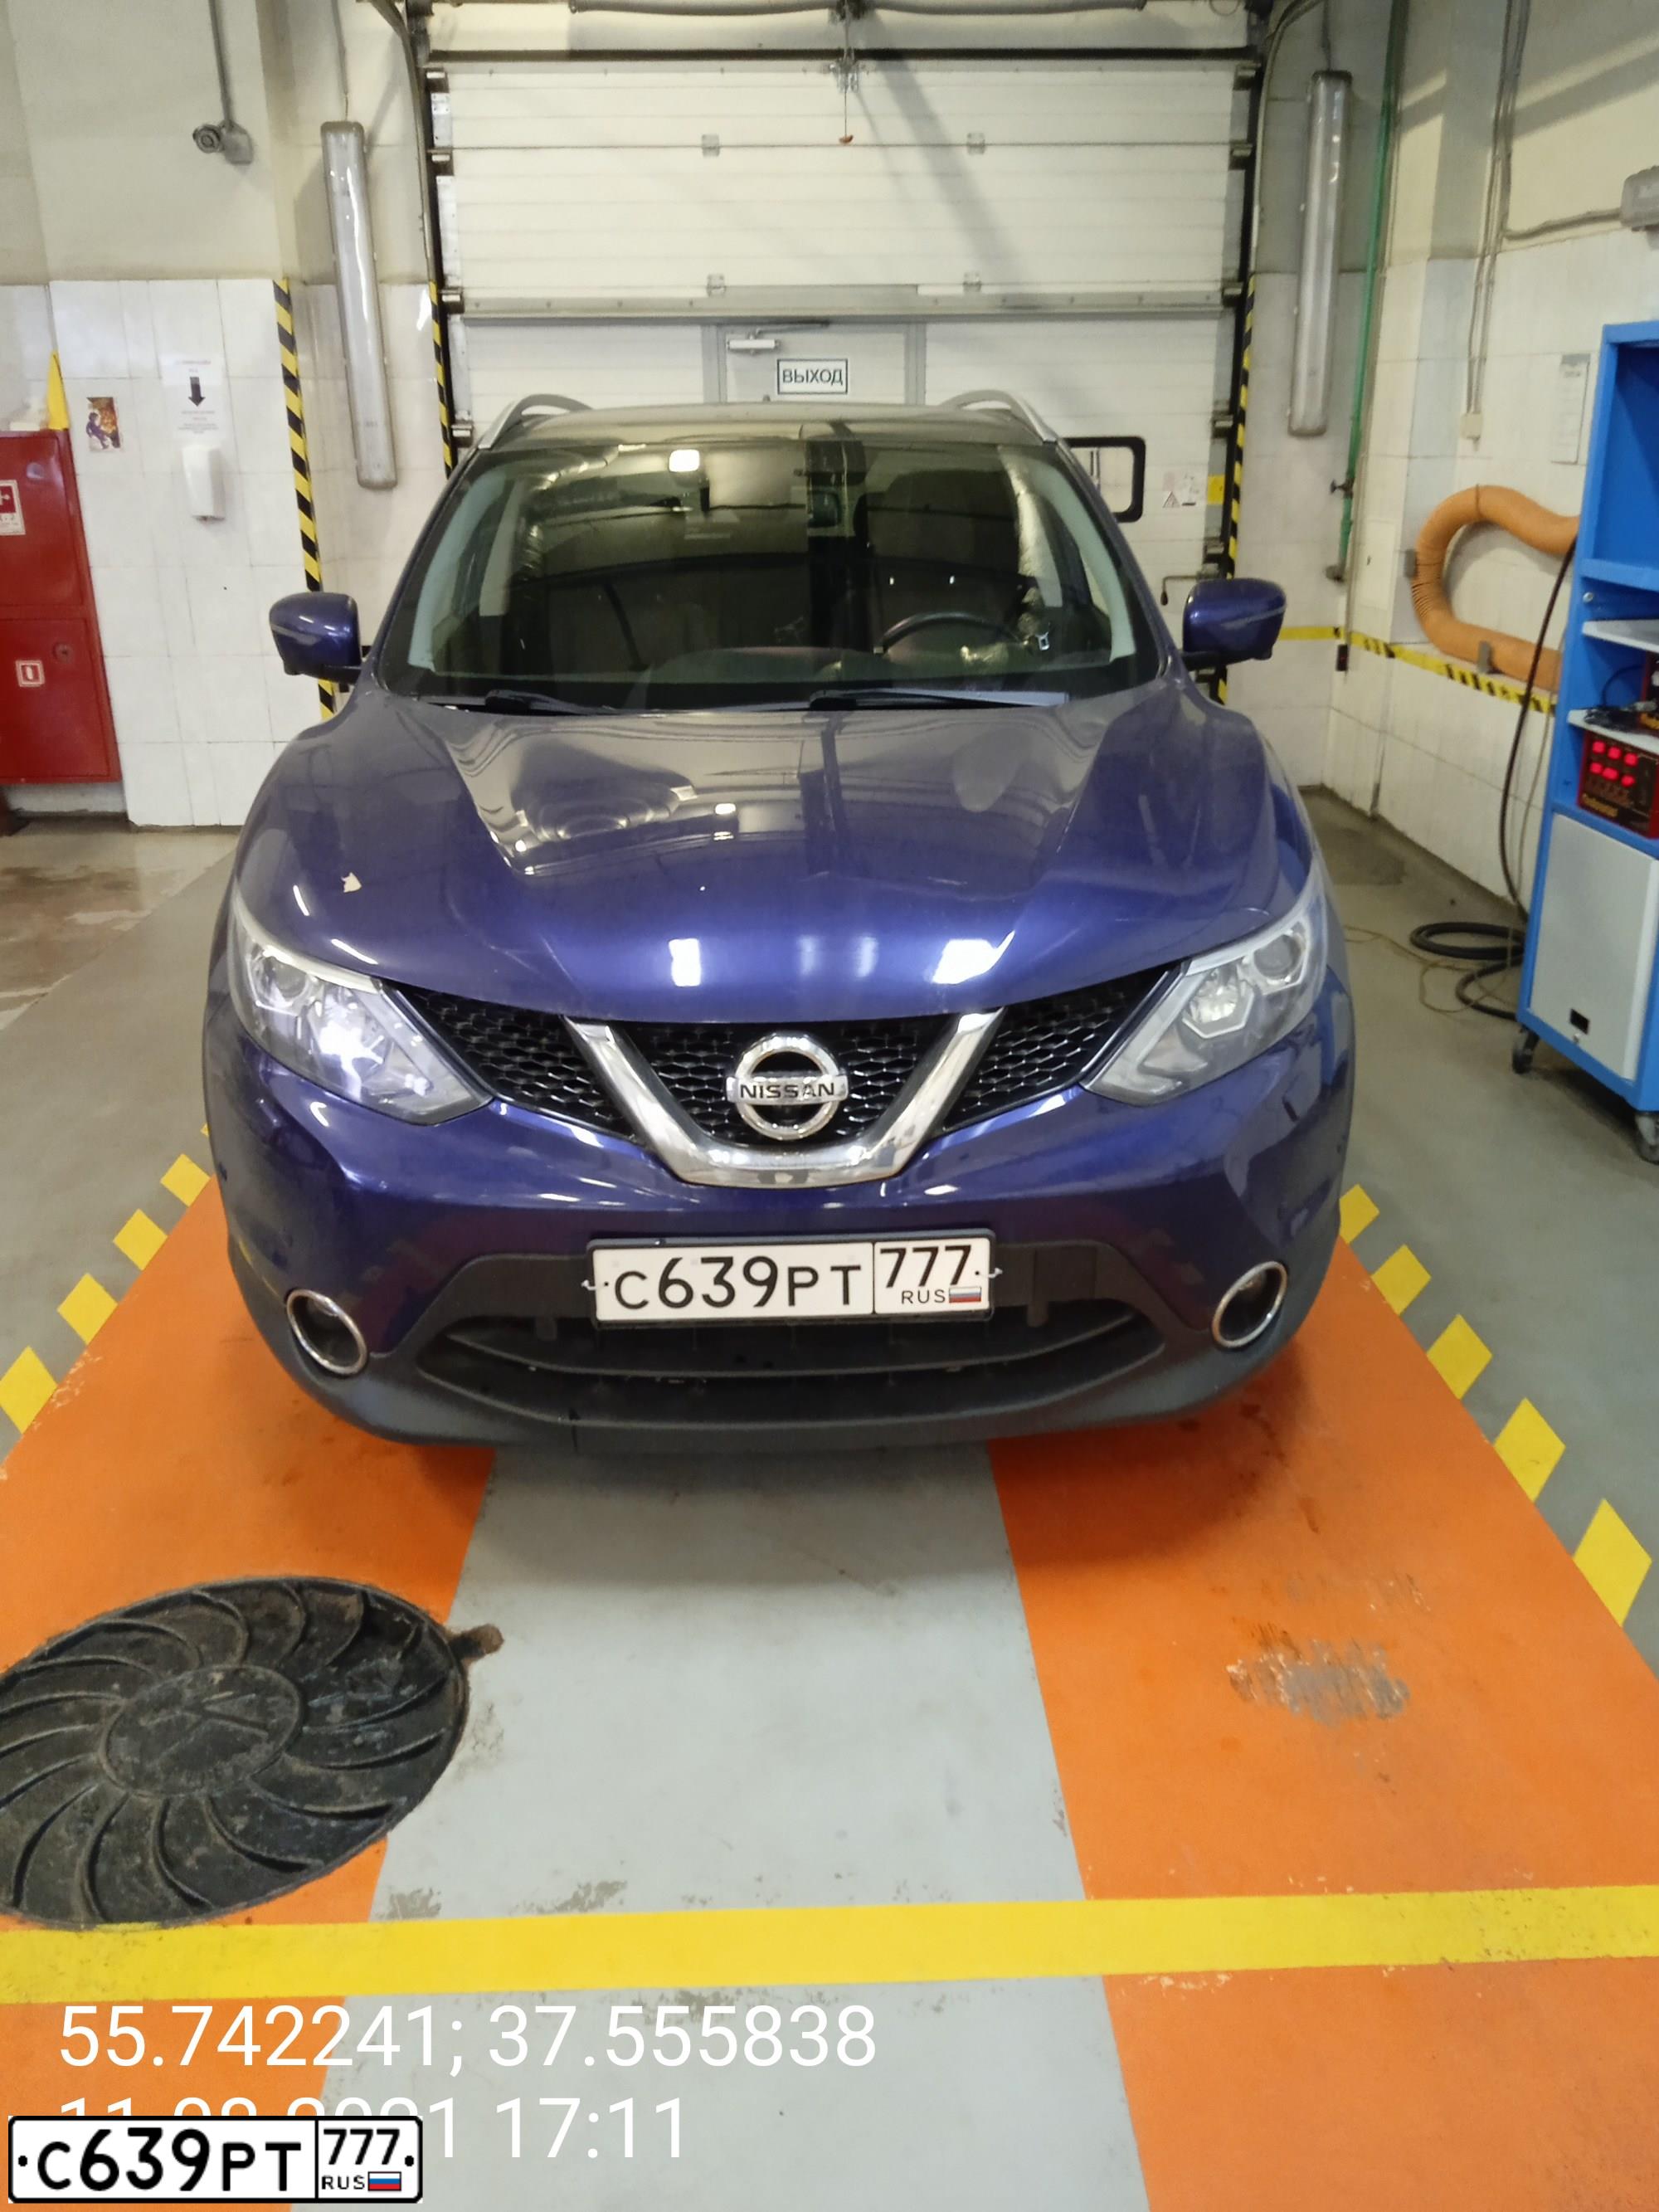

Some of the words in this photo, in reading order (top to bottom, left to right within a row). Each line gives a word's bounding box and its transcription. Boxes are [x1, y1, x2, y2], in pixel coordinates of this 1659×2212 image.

[782, 368, 844, 386] ВЫХОД
[740, 1082, 834, 1099] NISSAN
[879, 1245, 972, 1289] 777
[900, 1289, 946, 1304] RUS
